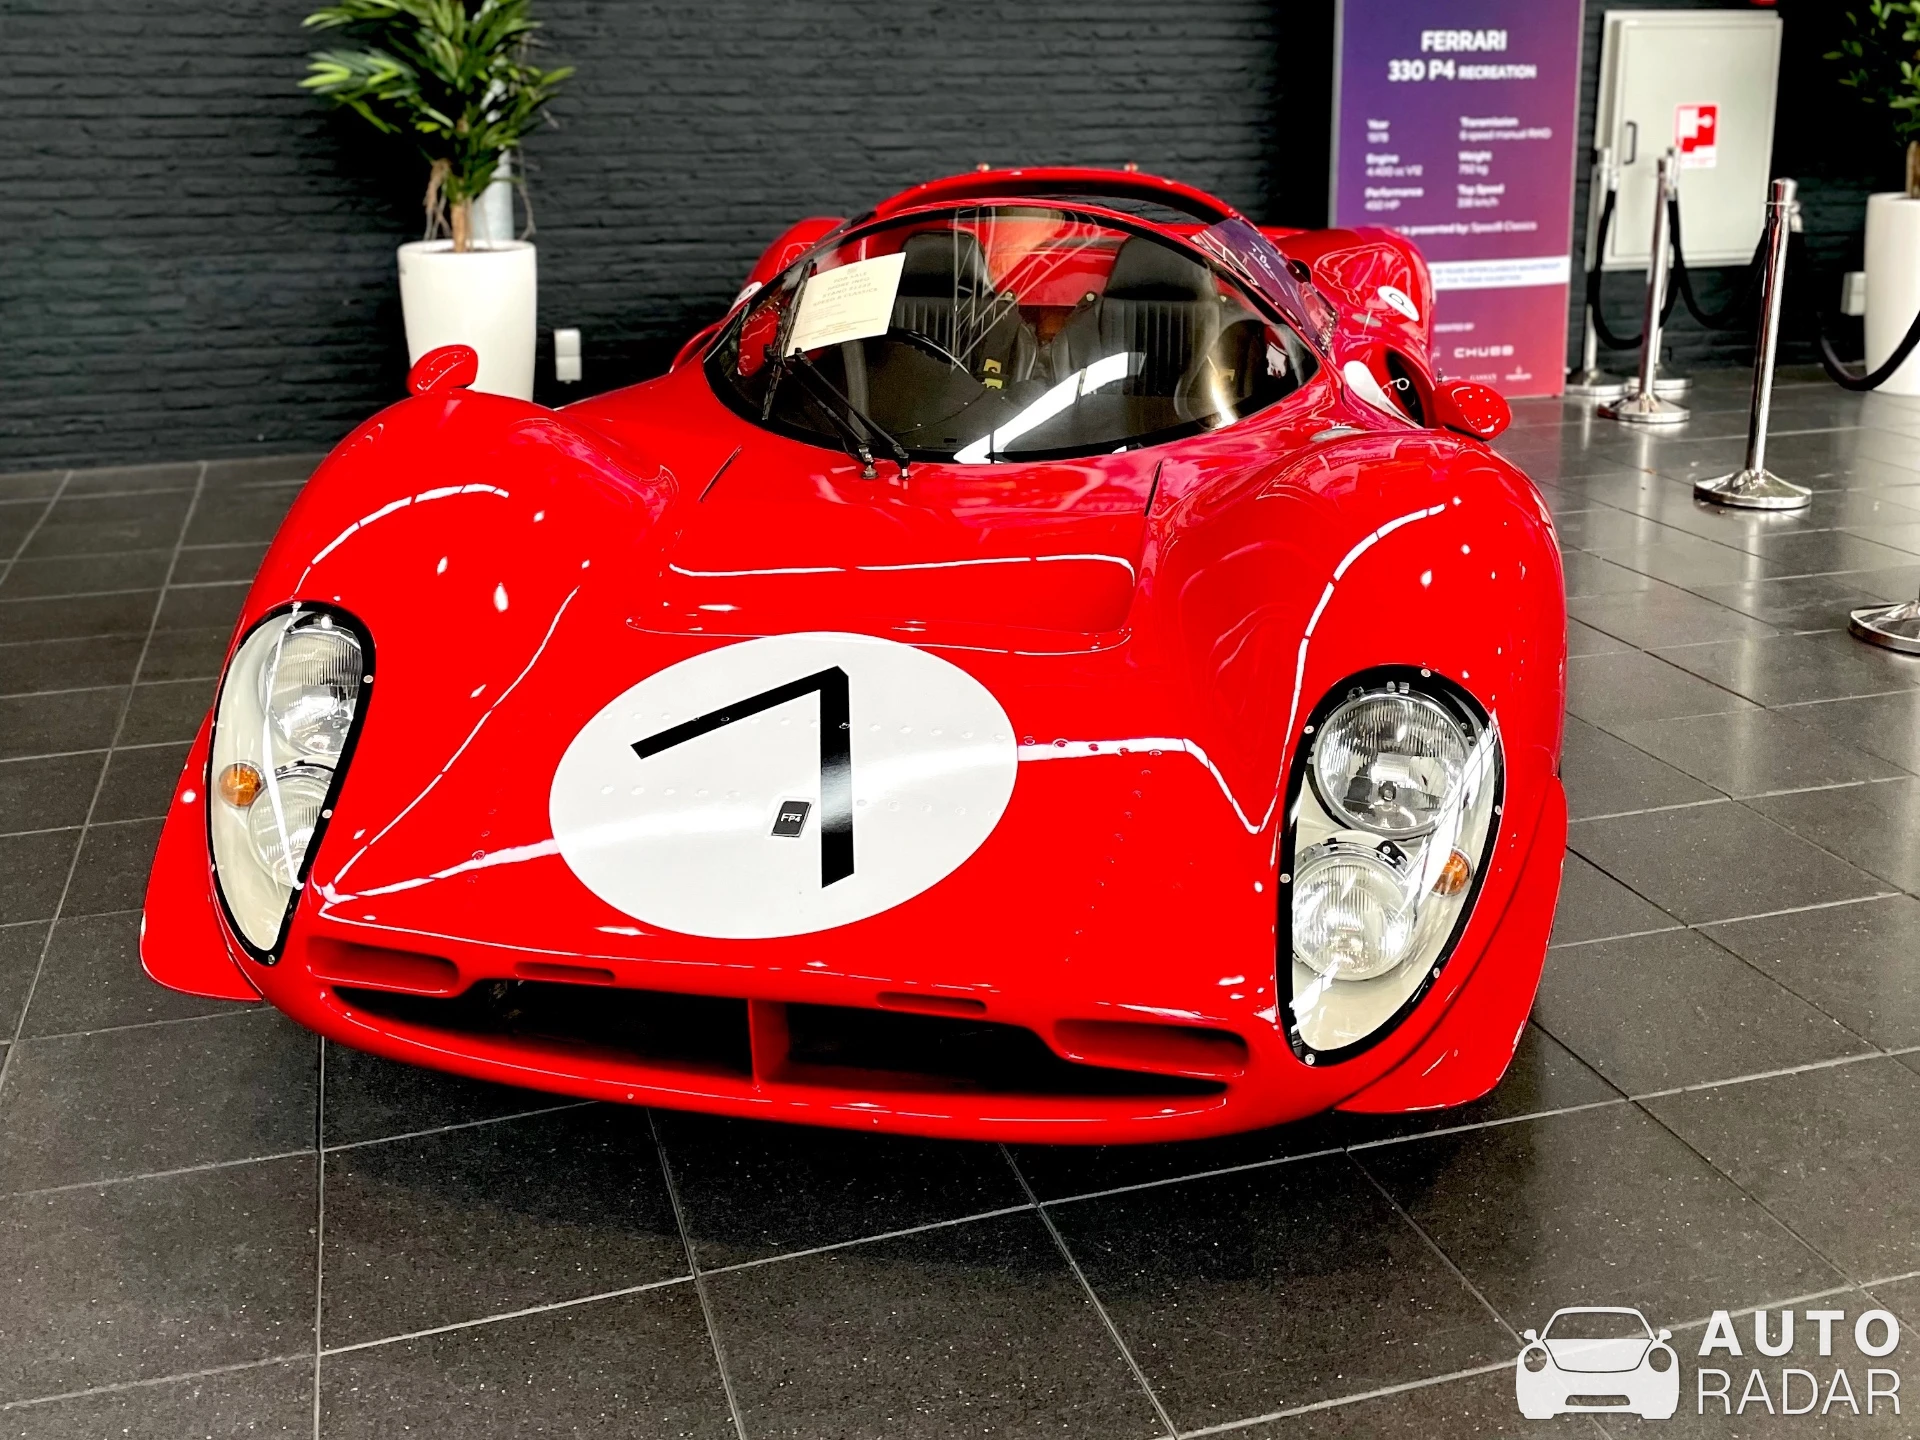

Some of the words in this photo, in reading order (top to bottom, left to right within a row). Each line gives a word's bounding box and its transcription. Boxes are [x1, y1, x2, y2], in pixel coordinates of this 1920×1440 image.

[1421, 30, 1508, 52] FERRARI
[1387, 59, 1425, 81] 330
[1428, 59, 1455, 81] P4
[1458, 64, 1537, 79] RECREATION
[1366, 153, 1399, 165] Engine
[1364, 187, 1424, 198] Performance
